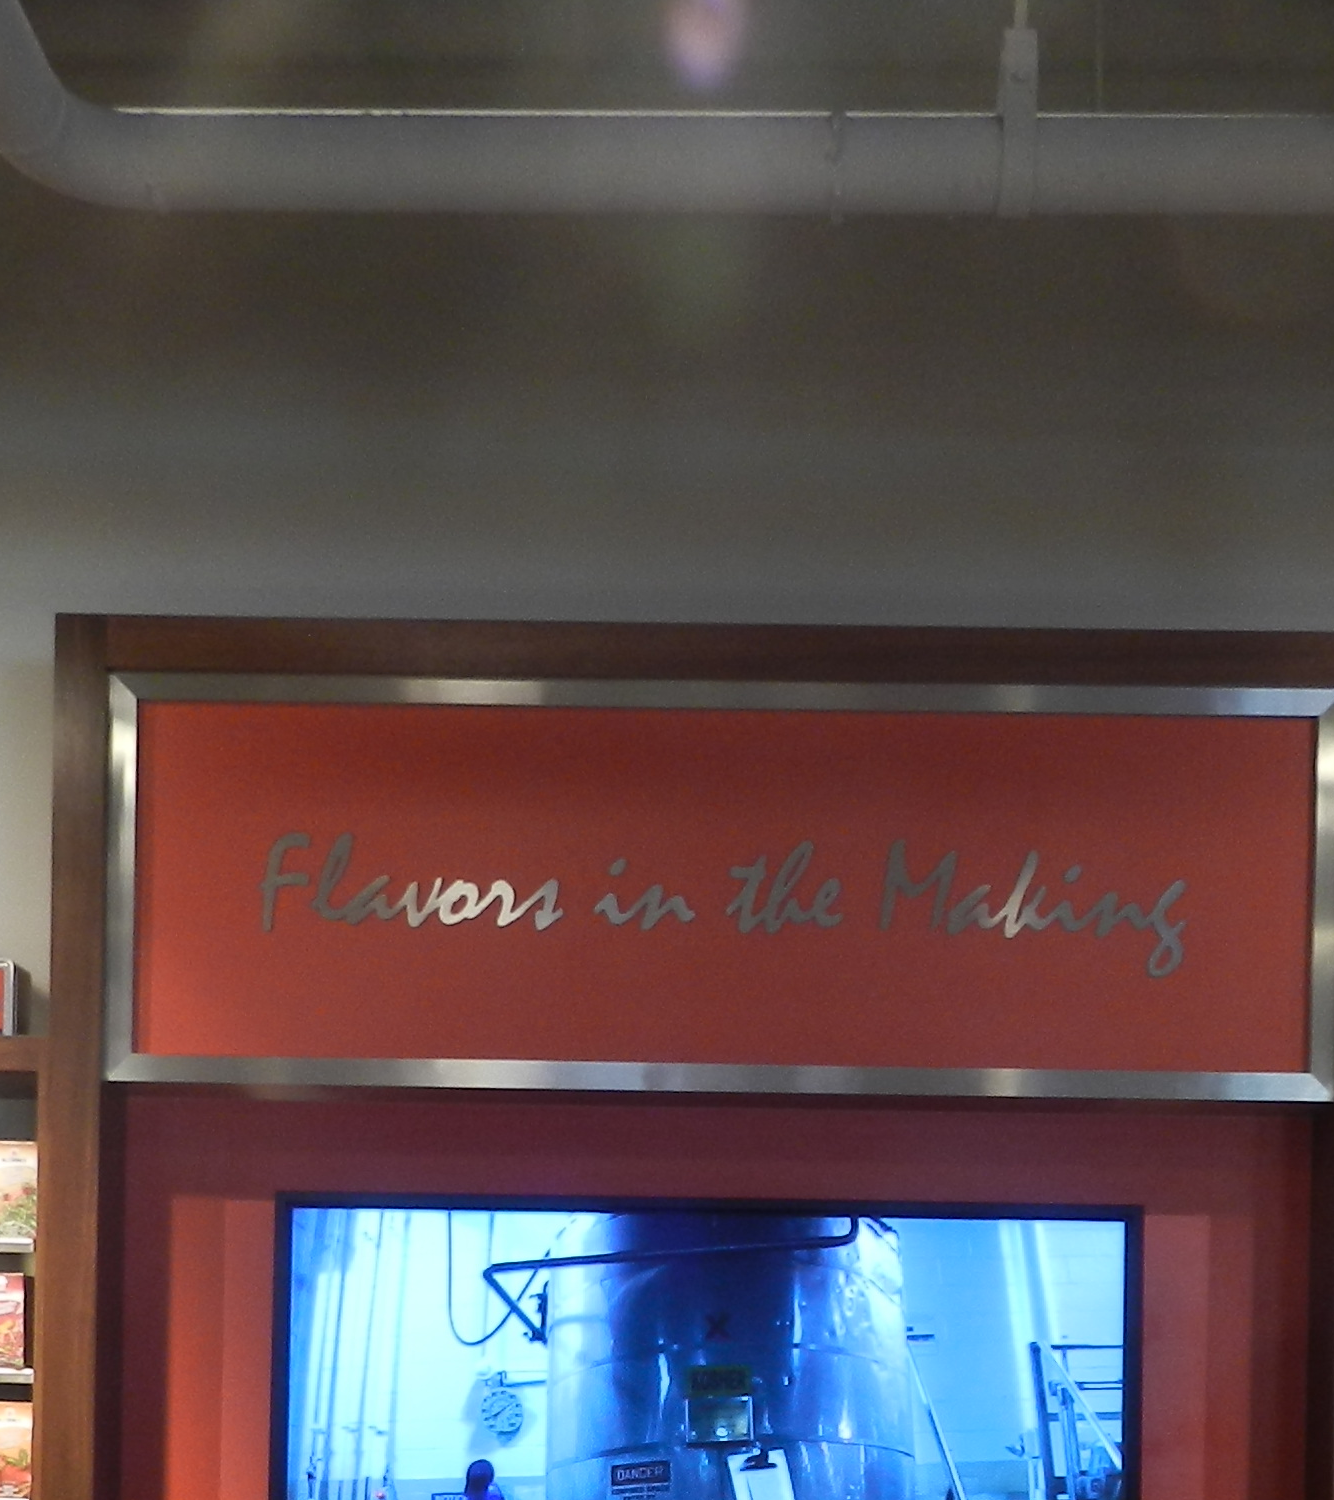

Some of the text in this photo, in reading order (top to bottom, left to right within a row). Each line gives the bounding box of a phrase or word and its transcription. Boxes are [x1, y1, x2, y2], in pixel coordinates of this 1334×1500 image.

[259, 832, 1189, 977] Flavors in the Making
